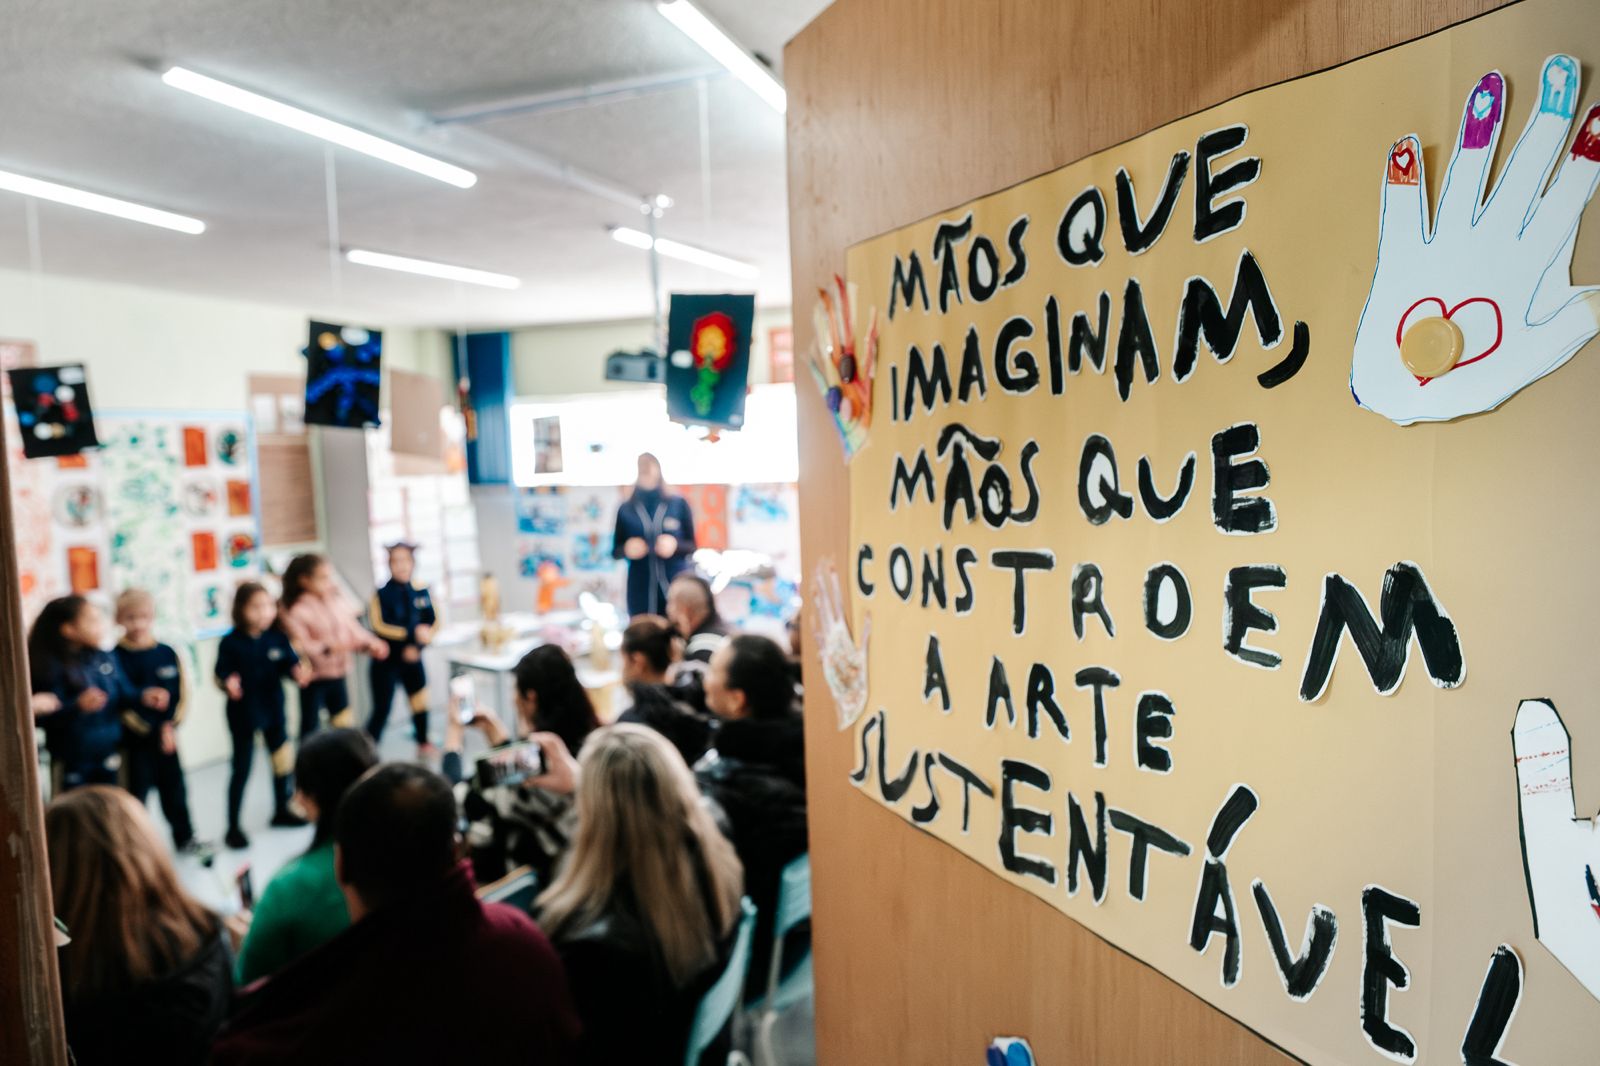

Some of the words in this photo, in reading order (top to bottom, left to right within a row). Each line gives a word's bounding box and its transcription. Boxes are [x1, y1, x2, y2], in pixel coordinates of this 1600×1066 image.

[888, 214, 1029, 319] MÃOS
[890, 251, 1311, 421] IMAGINAM,
[890, 423, 1040, 531] MÃOS
[1077, 424, 1274, 534] QUE
[856, 545, 1463, 701] CONSTROEM
[924, 636, 950, 711] A
[986, 657, 1176, 772] ARTE
[850, 711, 1520, 1066] SUSTENTÁVEL
